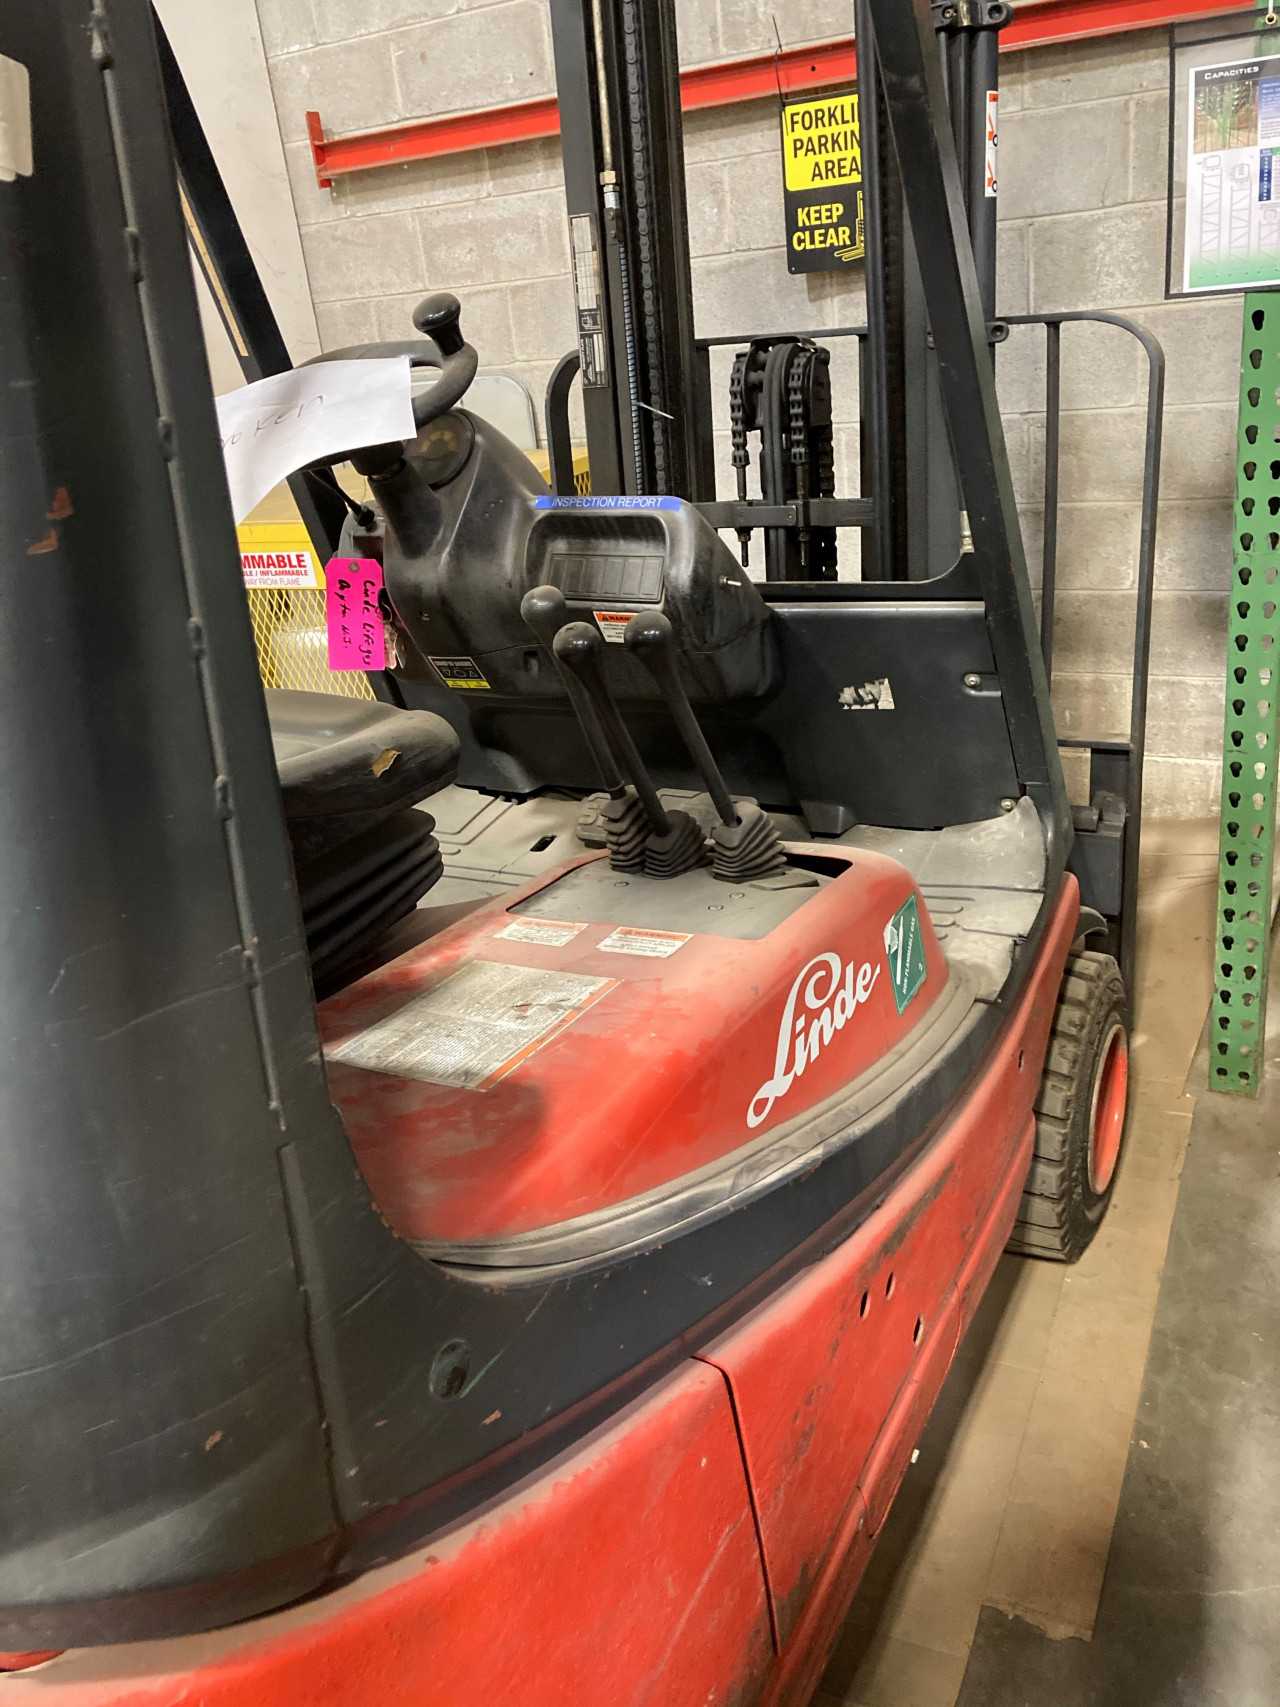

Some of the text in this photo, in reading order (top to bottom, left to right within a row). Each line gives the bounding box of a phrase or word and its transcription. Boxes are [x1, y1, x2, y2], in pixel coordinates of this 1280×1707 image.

[1204, 66, 1260, 80] CAPACITIES
[790, 102, 859, 132] FORKLI
[793, 130, 861, 158] PARKIN
[811, 155, 861, 182] AREA
[797, 203, 844, 227] KEEP
[792, 227, 850, 251] CLEAR
[551, 497, 663, 508] INSPECTION REPORT
[243, 554, 307, 568] MMABLE
[746, 952, 881, 1129] Linde
